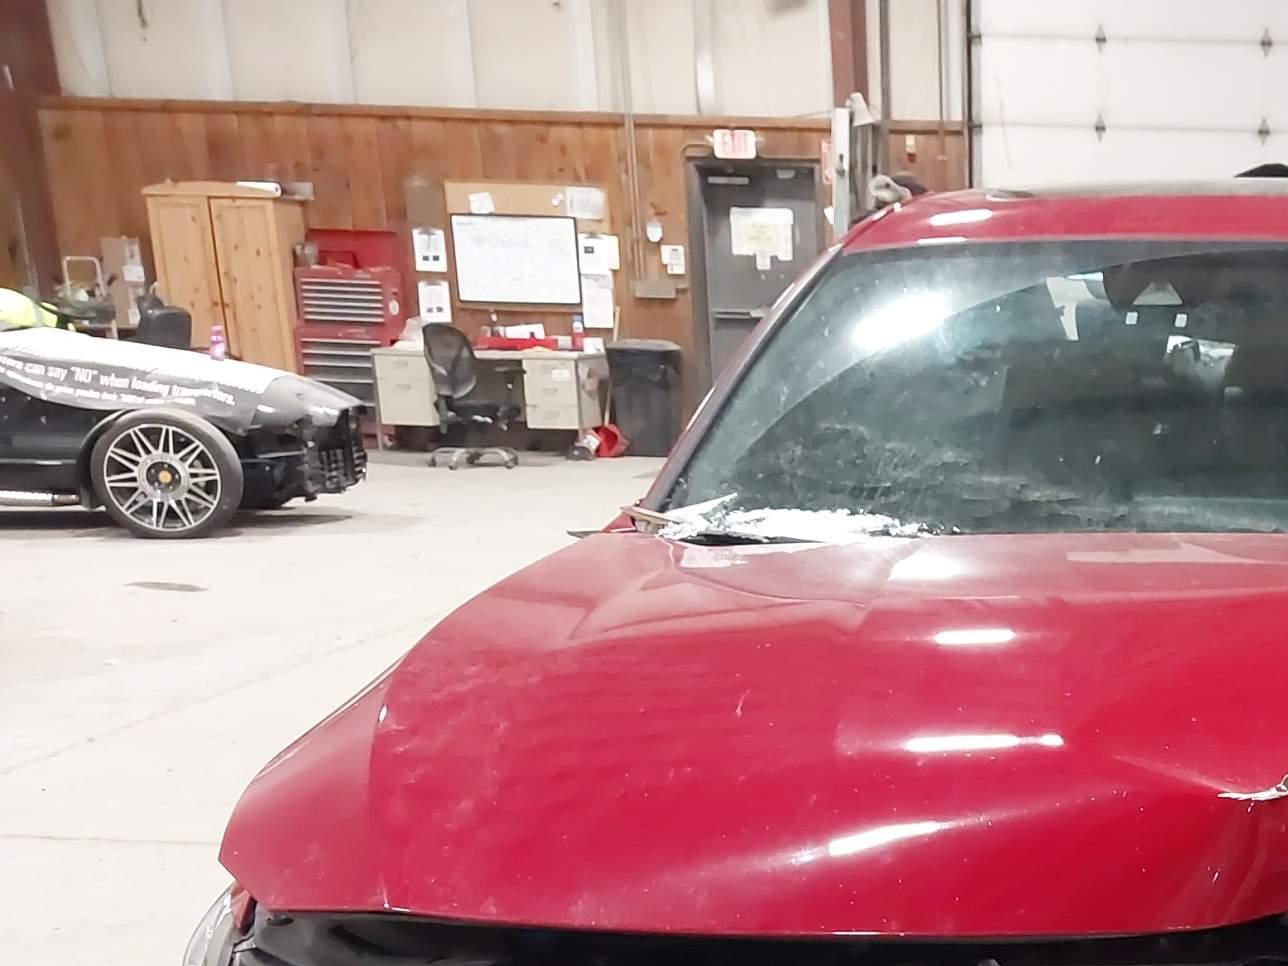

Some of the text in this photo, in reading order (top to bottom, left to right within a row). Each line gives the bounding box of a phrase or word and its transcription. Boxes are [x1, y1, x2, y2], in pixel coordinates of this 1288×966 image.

[24, 362, 45, 376] can
[47, 366, 67, 382] say
[70, 366, 98, 383] "NO"
[99, 372, 129, 389] when
[131, 375, 170, 397] loading
